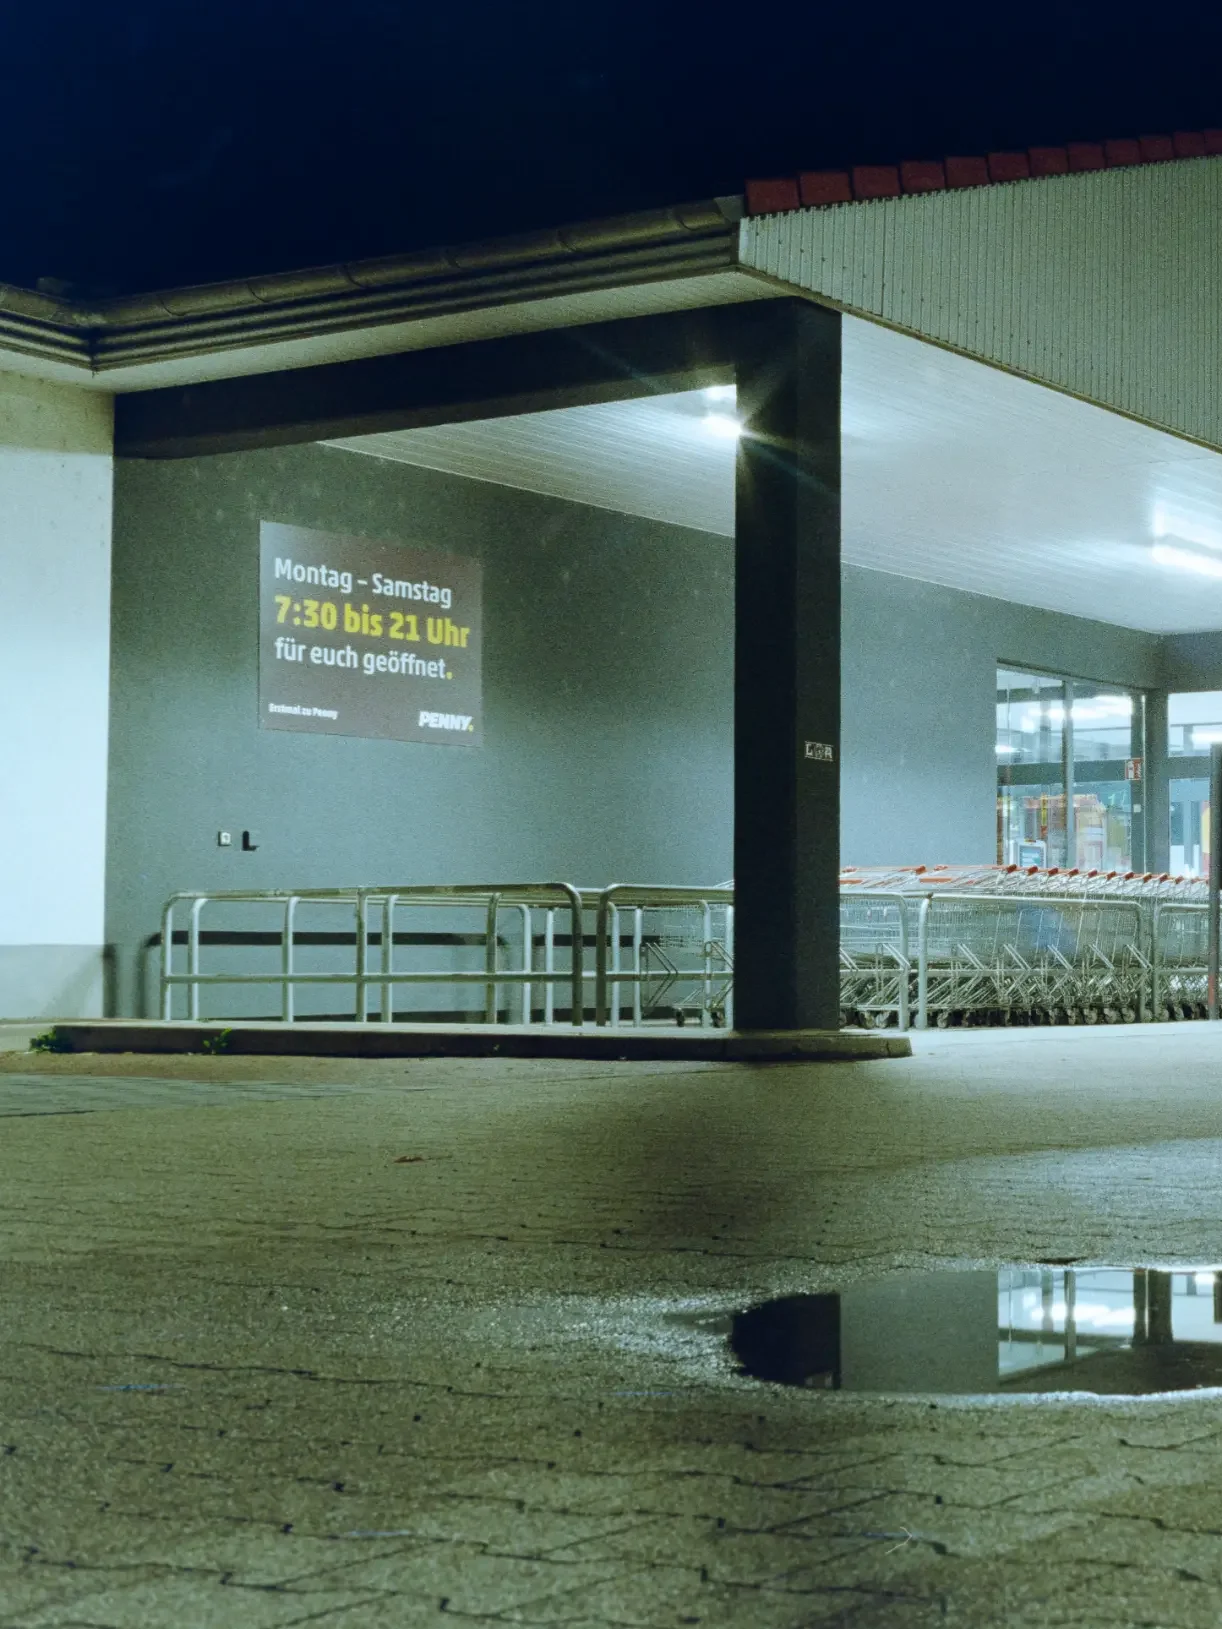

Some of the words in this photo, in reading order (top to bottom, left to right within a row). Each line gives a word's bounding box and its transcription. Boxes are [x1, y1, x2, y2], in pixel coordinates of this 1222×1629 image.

[275, 557, 352, 594] Montag
[372, 573, 452, 609] Samstag
[274, 595, 337, 630] 7:30
[344, 603, 383, 637] bis
[389, 611, 421, 642] 21
[426, 617, 470, 648] Uhr
[274, 637, 306, 662] für
[310, 645, 358, 669] euch
[363, 651, 453, 680] geöffnet.
